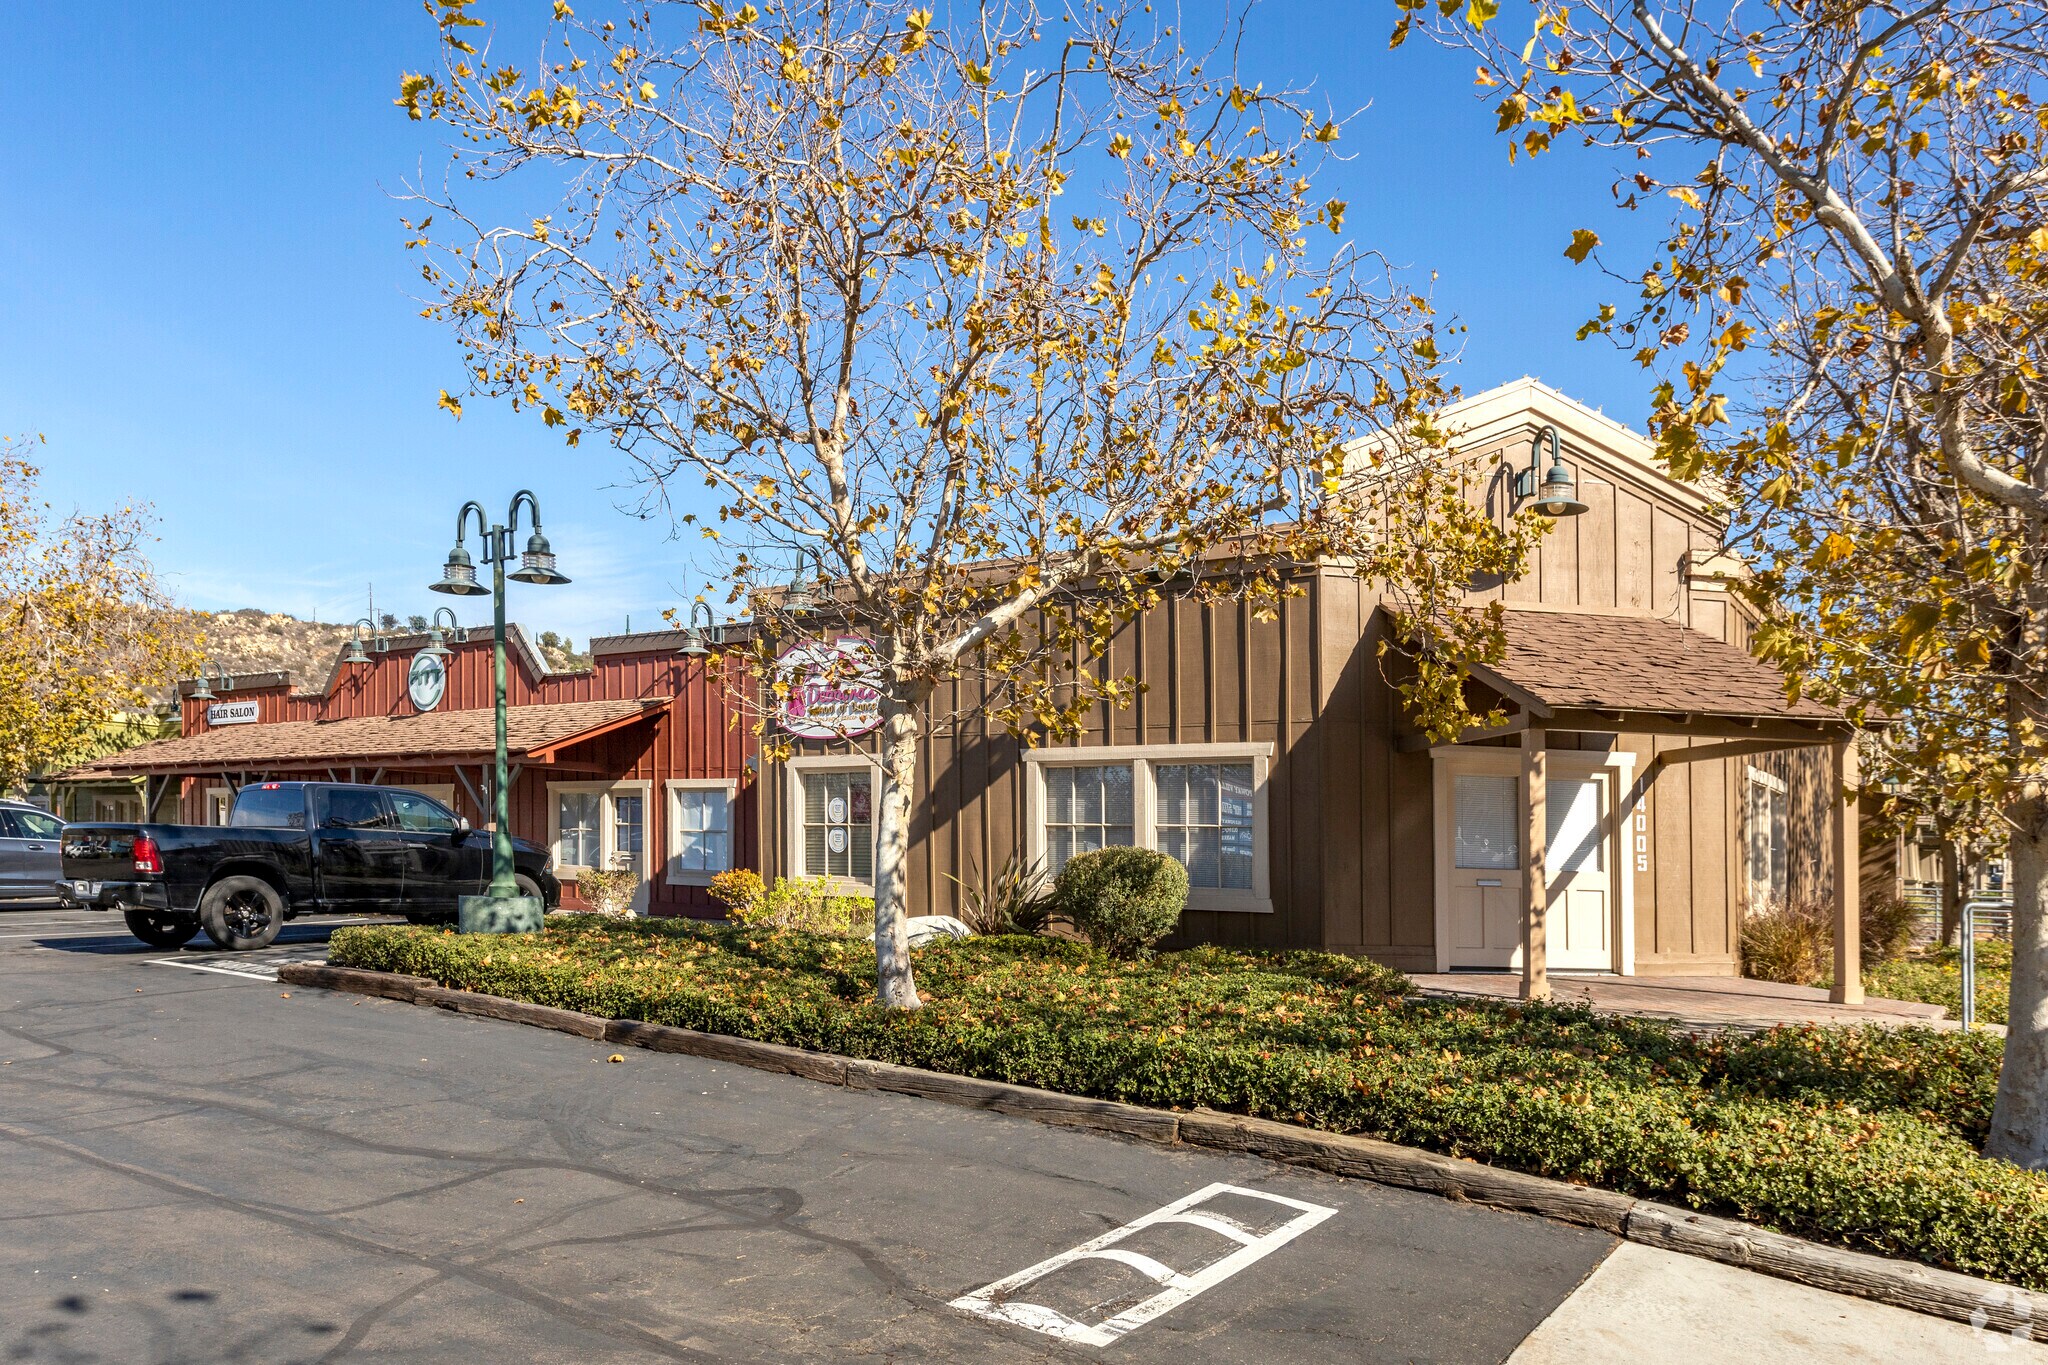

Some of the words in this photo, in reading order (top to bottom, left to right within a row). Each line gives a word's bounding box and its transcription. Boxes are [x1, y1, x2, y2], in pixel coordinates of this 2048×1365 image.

[210, 709, 228, 719] HAIR
[230, 707, 255, 718] SALON
[1636, 776, 1648, 872] 14005
